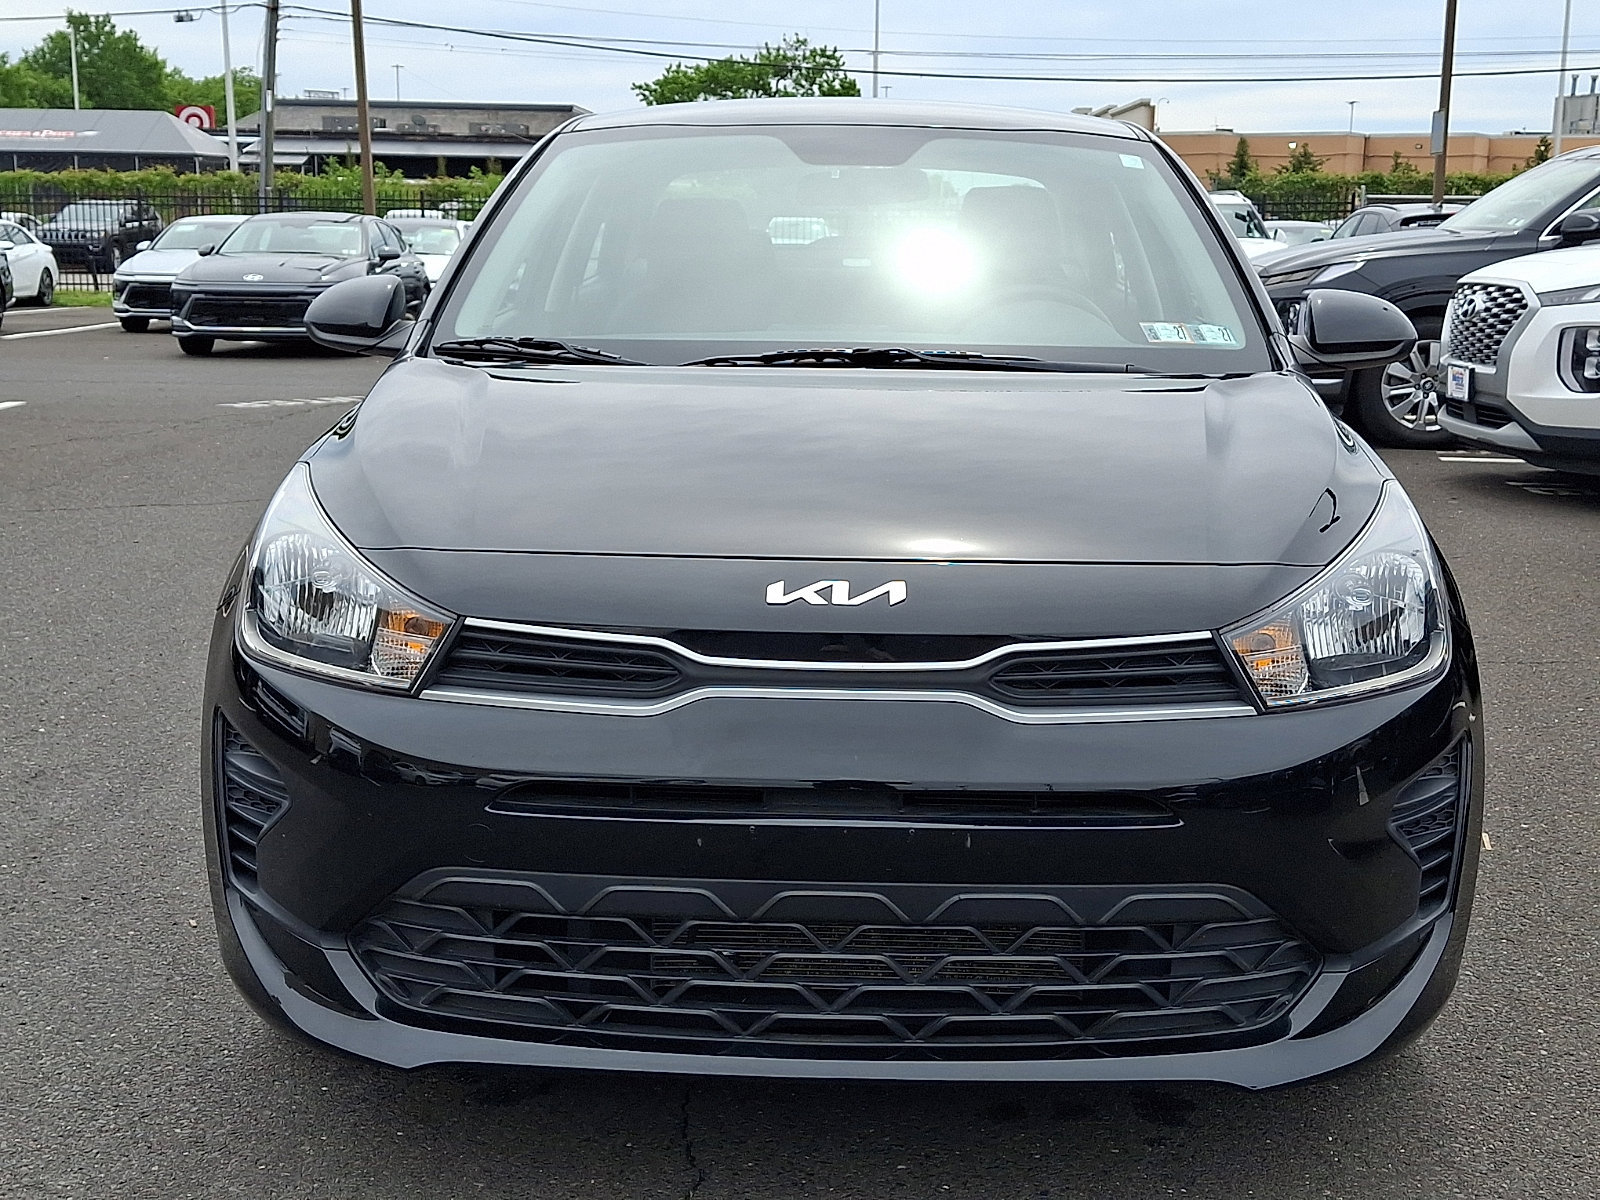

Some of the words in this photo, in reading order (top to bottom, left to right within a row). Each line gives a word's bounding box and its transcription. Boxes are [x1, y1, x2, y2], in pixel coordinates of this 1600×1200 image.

[1173, 325, 1187, 340] 27
[1218, 327, 1232, 342] 27
[765, 579, 907, 607] KIA
